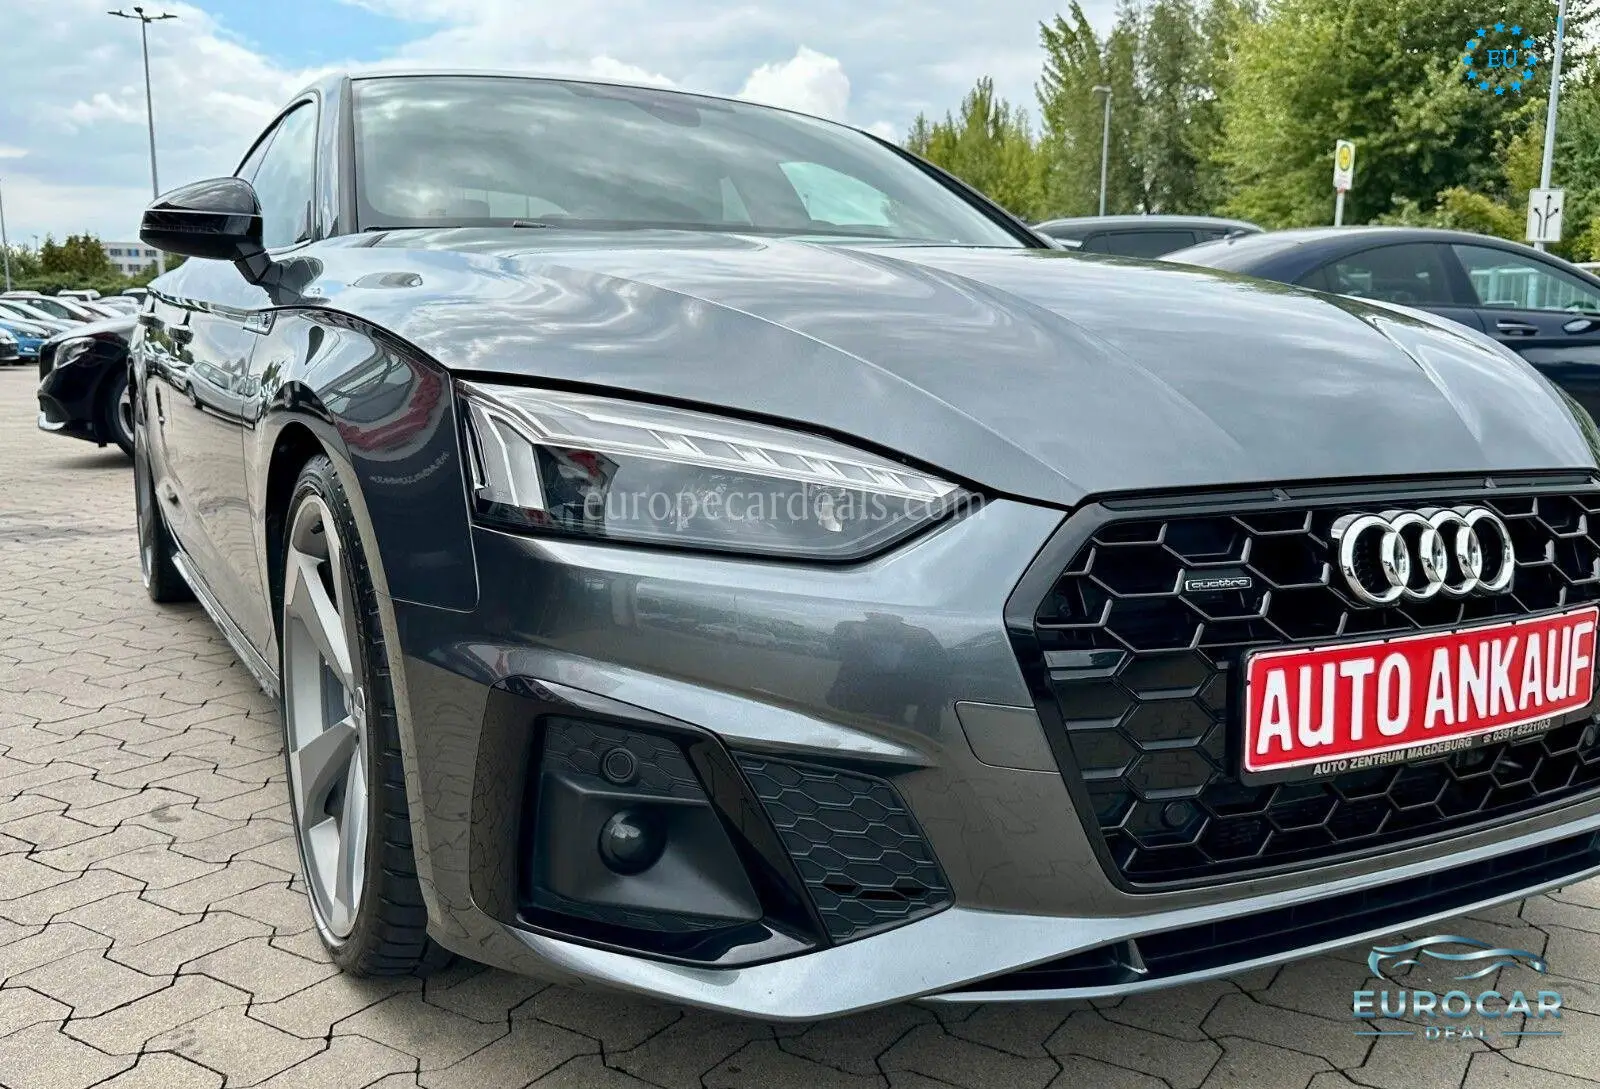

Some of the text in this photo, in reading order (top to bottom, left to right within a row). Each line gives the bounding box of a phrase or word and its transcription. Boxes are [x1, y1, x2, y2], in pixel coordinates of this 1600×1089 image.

[1191, 579, 1248, 590] quattro
[1256, 620, 1595, 755] AUTO ANKAUF
[1313, 760, 1347, 776] AUTO
[1350, 750, 1405, 770] ZENTRUM
[1407, 737, 1473, 759] MAGDEBURG
